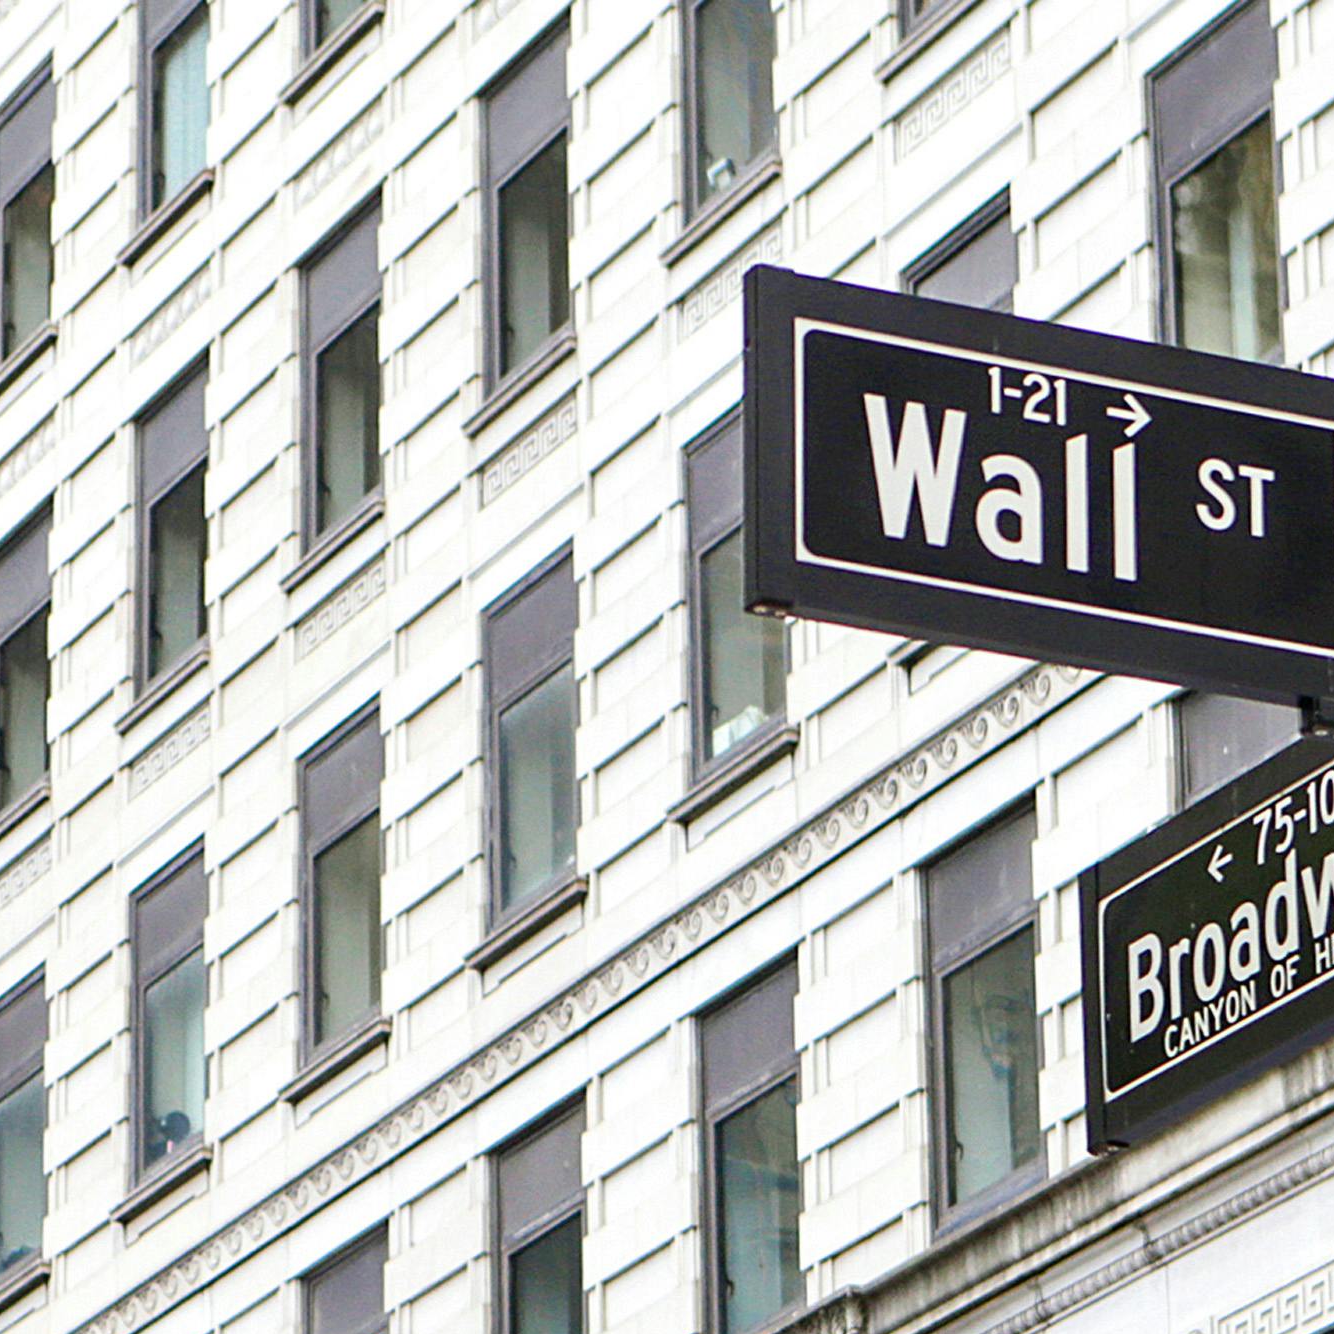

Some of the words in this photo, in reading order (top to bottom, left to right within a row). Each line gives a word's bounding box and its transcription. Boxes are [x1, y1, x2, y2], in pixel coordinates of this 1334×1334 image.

[987, 366, 1067, 427] 1-21
[864, 393, 1137, 582] Wall
[1195, 458, 1275, 538] ST
[1164, 980, 1257, 1058] CANYON
[1270, 954, 1300, 996] OF
